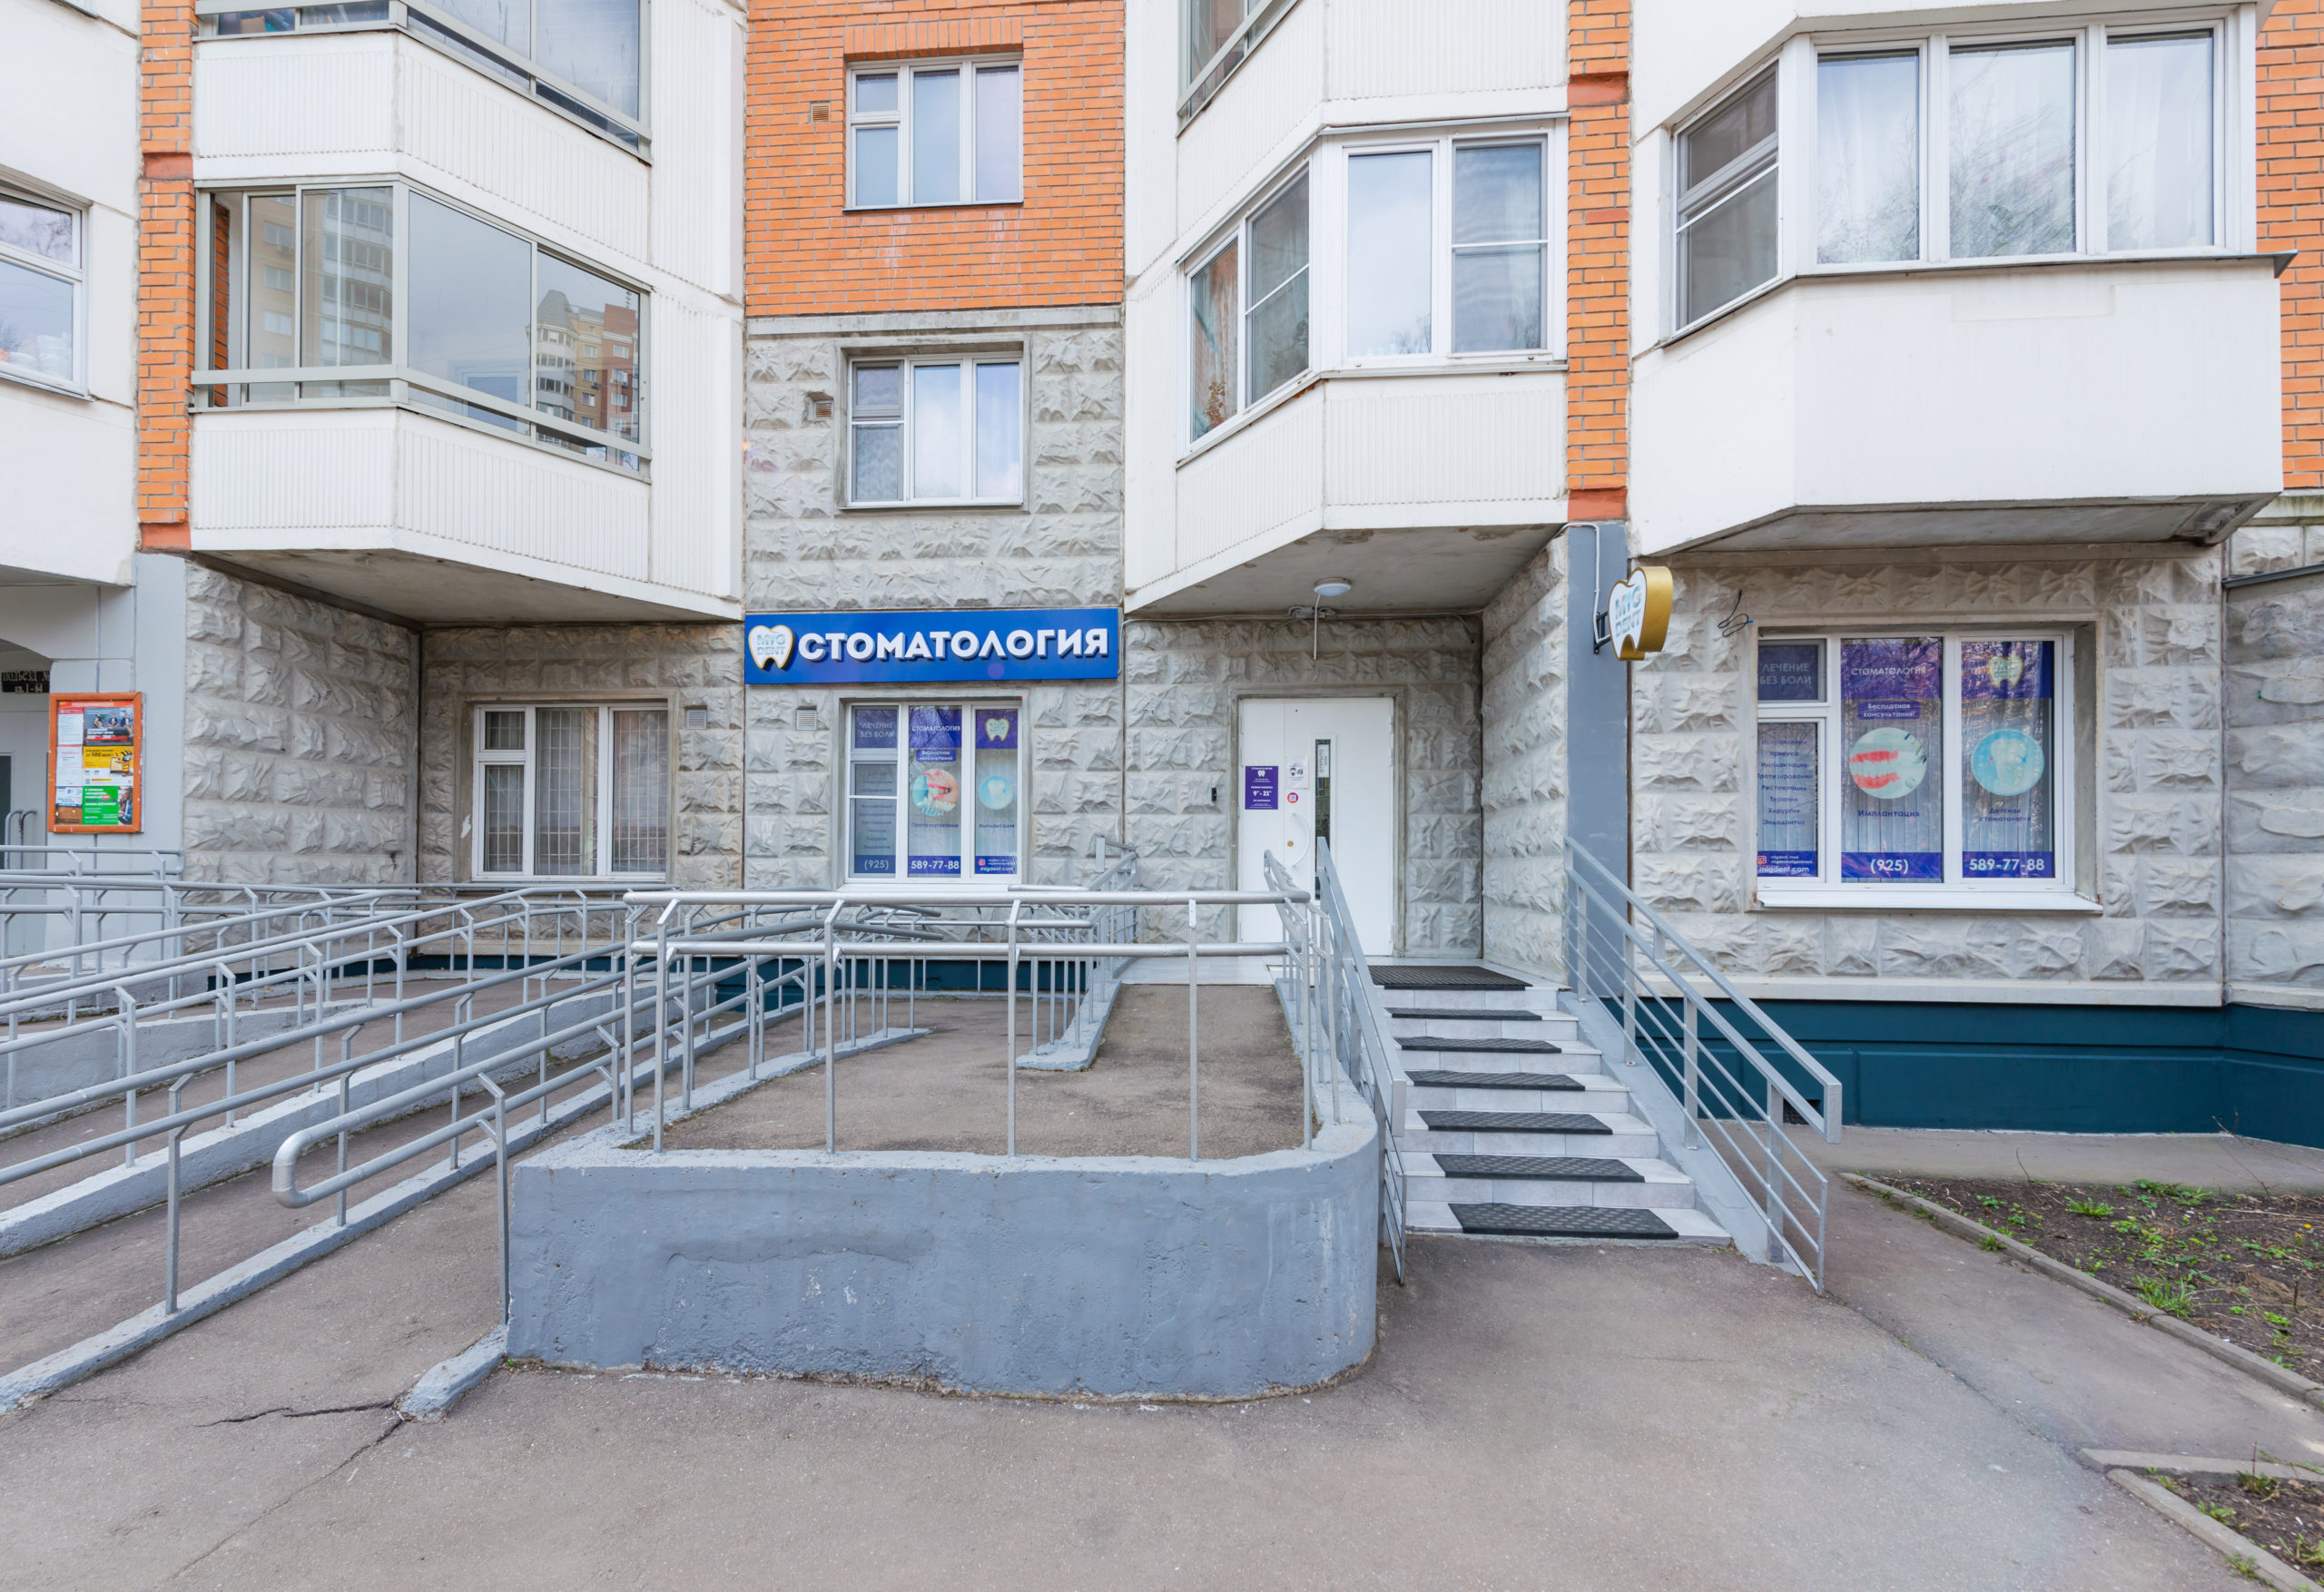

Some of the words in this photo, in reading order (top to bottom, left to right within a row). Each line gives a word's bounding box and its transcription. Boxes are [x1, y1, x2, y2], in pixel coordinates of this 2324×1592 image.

[798, 628, 1108, 662] СТОМАТОЛОГИЯ
[757, 646, 786, 655] DENT
[1762, 663, 1809, 672] ЛЕЧЕНИЕ
[1852, 667, 1926, 675] СТОМАТОЛОГИЯ
[1760, 675, 1777, 684] БЕЗ
[1781, 675, 1812, 684] БОЛИ
[864, 860, 890, 870] (925)
[911, 860, 960, 870] 589-77-88
[1870, 859, 1909, 874] (925)
[1969, 859, 2045, 870] 589-77-88
